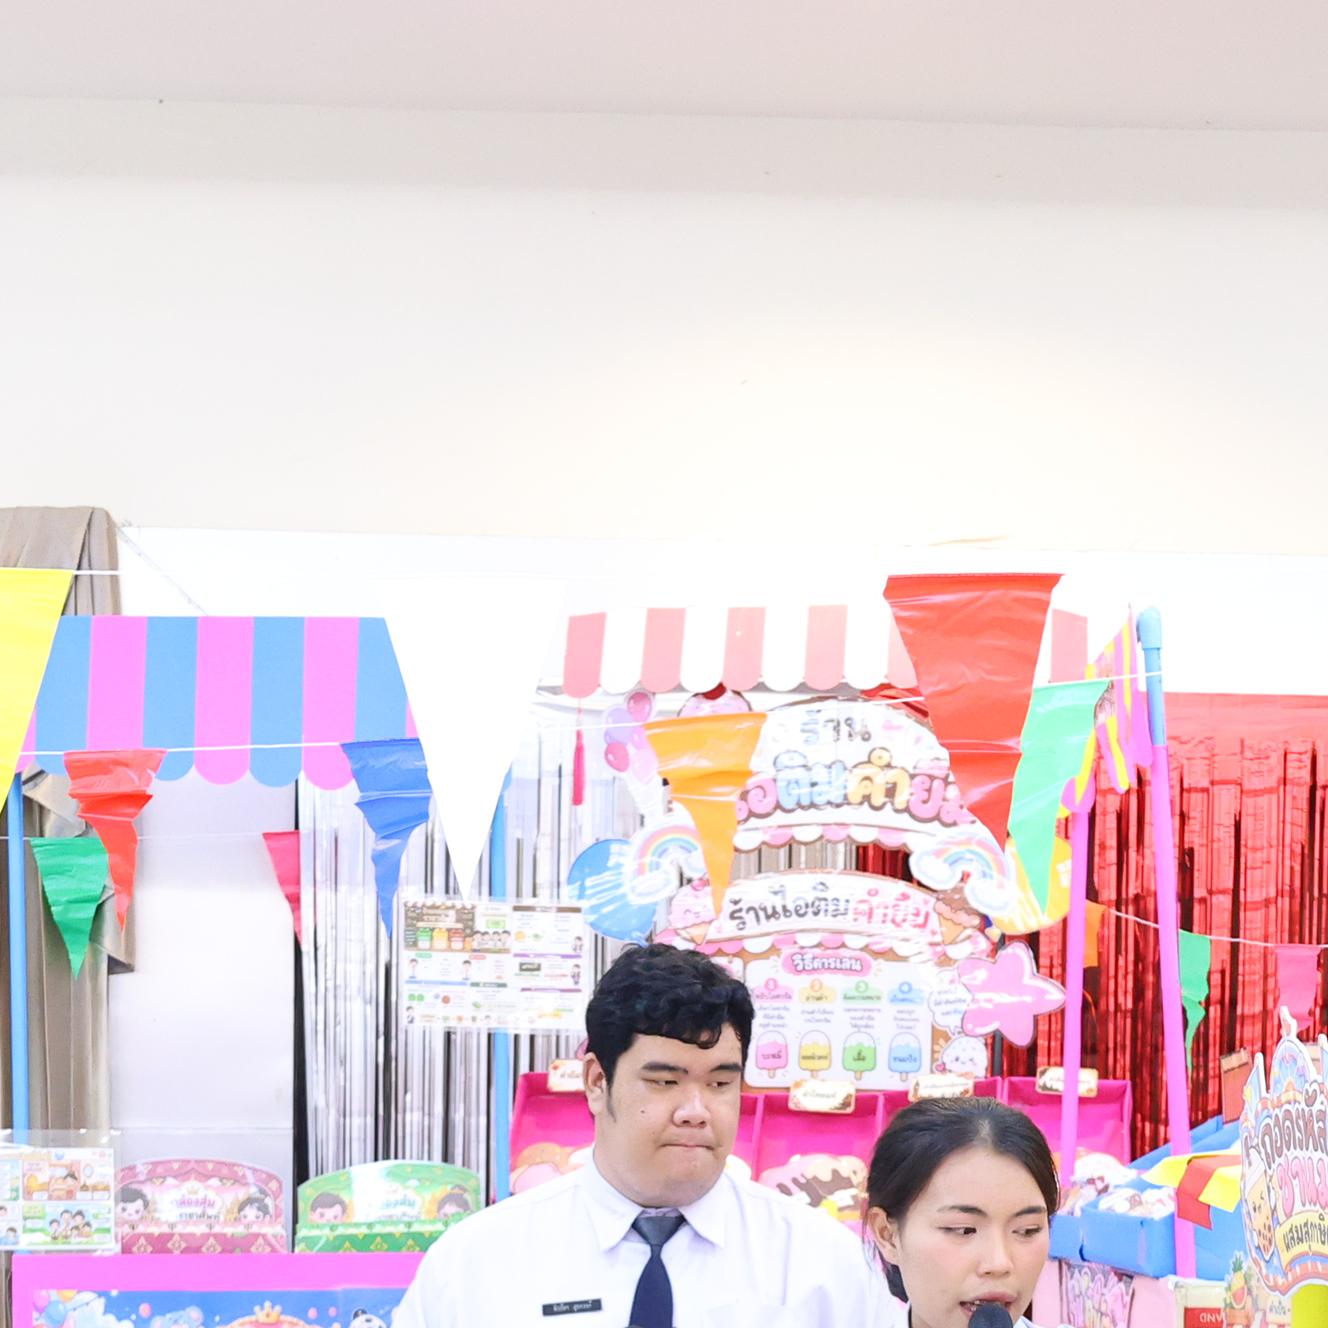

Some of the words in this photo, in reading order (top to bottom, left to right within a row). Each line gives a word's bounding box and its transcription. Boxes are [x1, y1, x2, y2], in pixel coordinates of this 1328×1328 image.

[800, 708, 872, 745] ร้าน
[1261, 1086, 1328, 1170] ถอดรหัส
